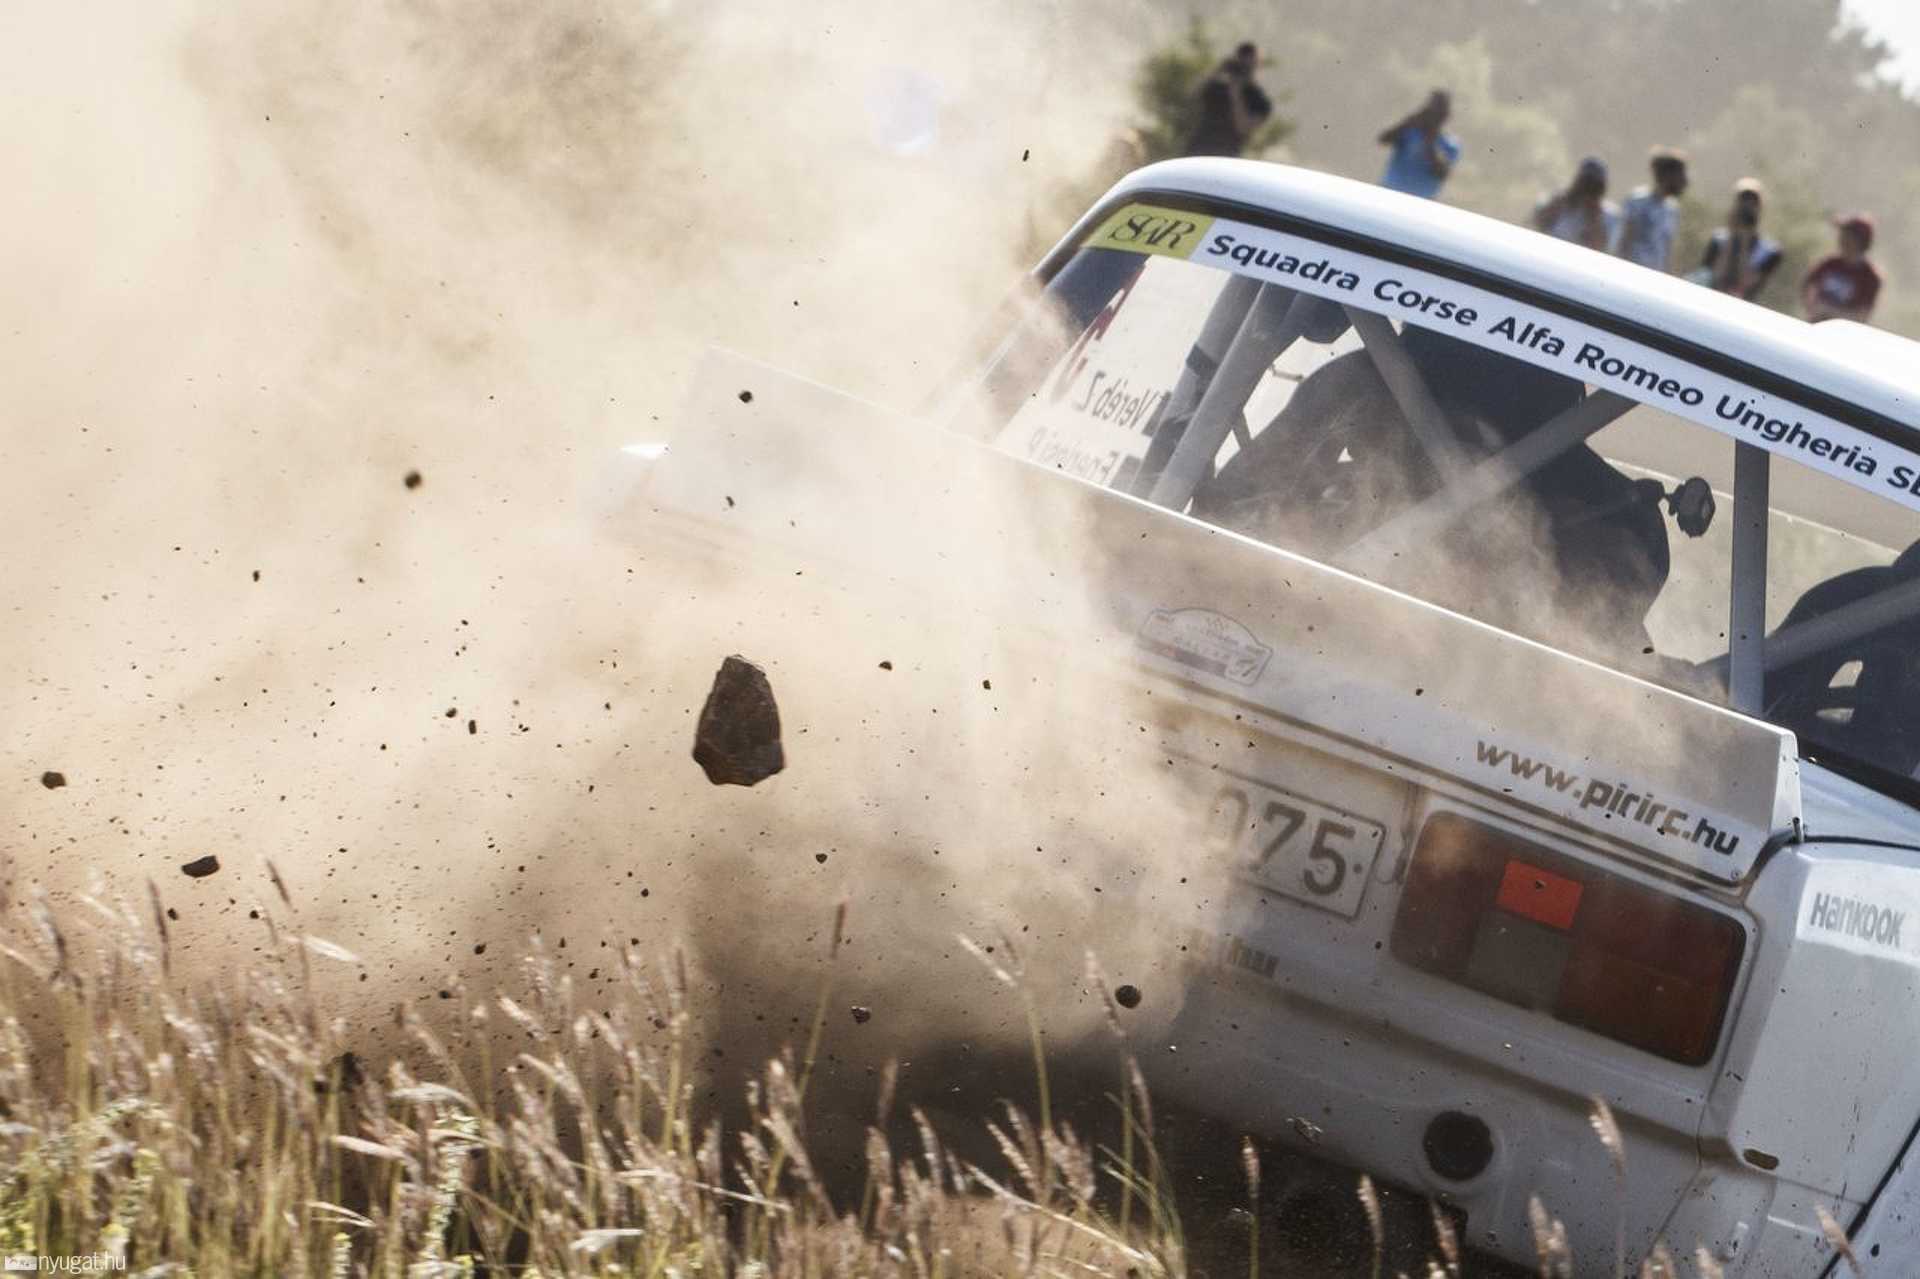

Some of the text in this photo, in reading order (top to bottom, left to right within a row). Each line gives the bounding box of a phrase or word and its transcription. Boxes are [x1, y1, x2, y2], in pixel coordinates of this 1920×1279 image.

[1207, 234, 1361, 292] Squadra
[1373, 279, 1479, 327] Corse
[1488, 316, 1566, 358] Alfa
[1573, 342, 1704, 406] Romeo
[1715, 394, 1879, 477] Ungheria
[1476, 740, 1740, 856] www.pirirc.hu
